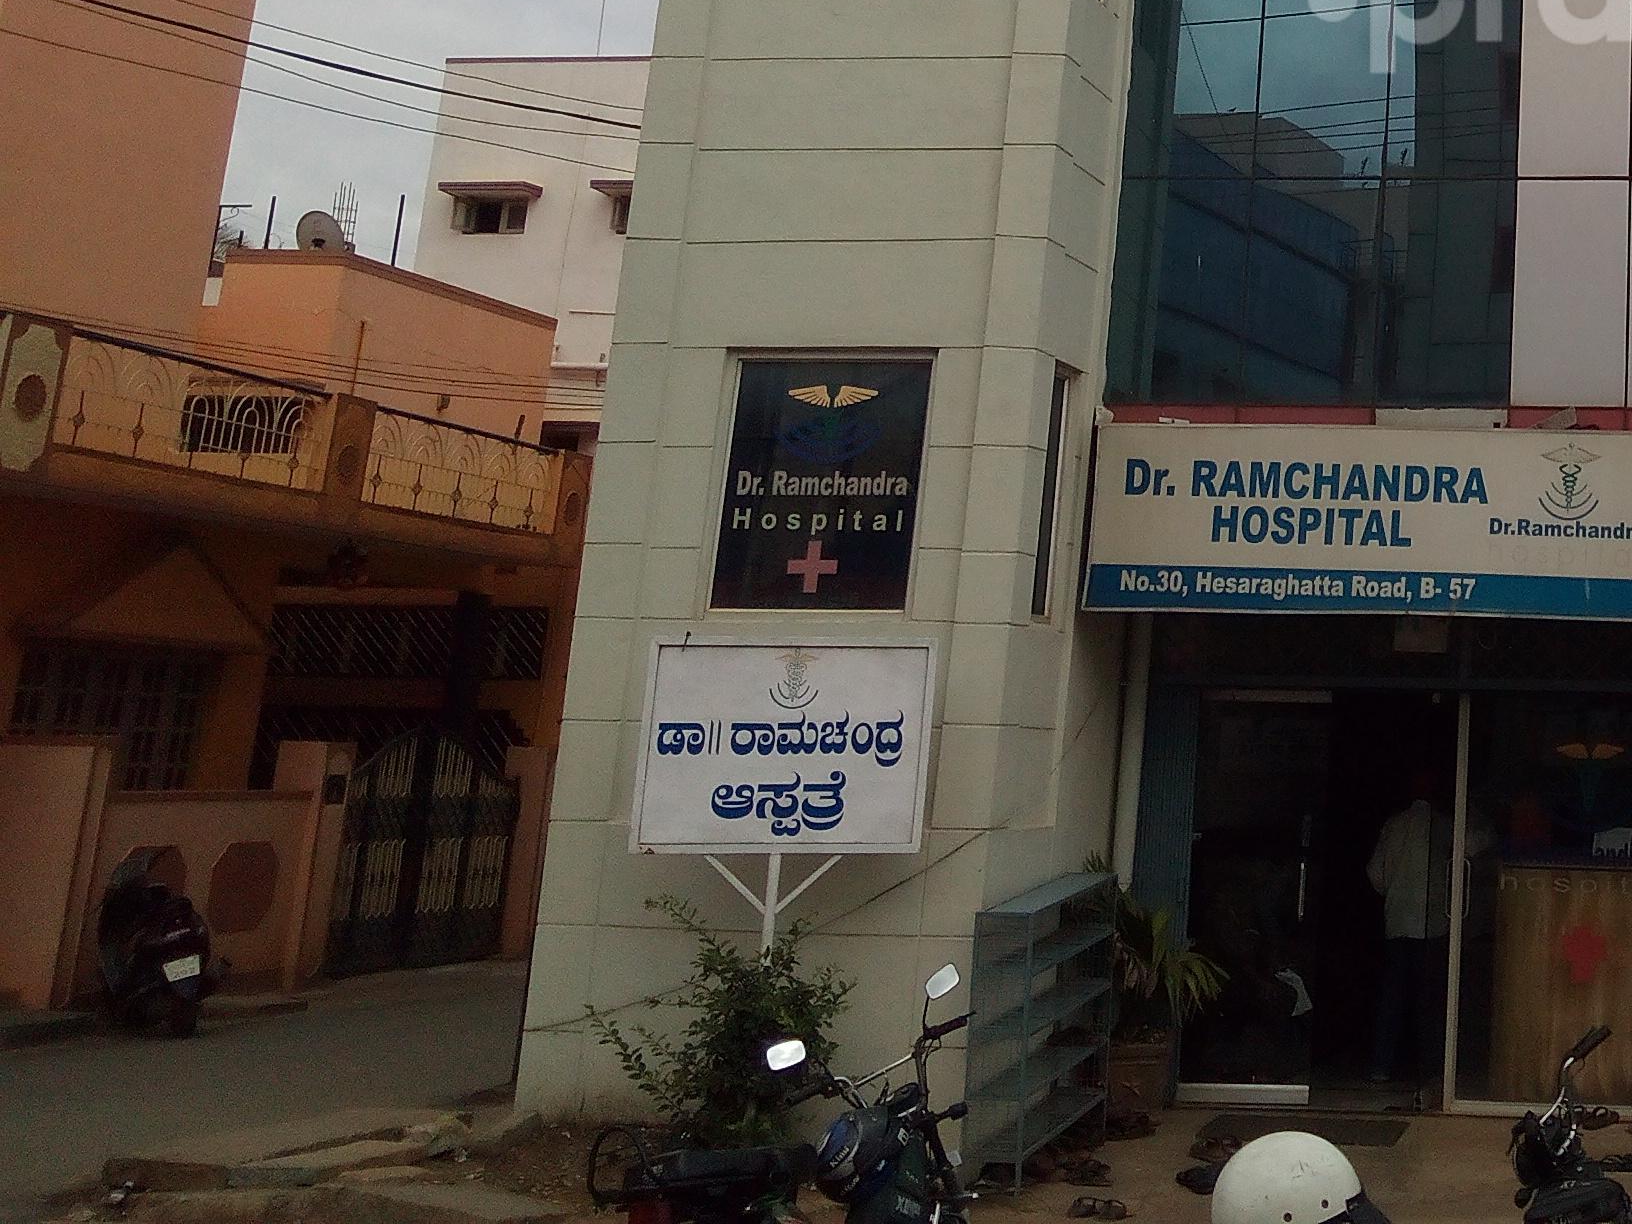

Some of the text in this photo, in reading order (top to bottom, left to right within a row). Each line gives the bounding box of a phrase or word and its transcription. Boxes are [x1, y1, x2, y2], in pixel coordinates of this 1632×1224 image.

[735, 470, 908, 498] Dr. Ramchandra
[1124, 458, 1488, 505] Dr. RAMCHANDRA
[732, 507, 903, 536] Hospital
[1210, 506, 1412, 548] HOSPITAL
[1119, 570, 1188, 596] No.30,
[1195, 572, 1344, 602] Hesaraghatta
[1351, 577, 1414, 604] Road,
[729, 709, 905, 768] ರಾಮಚಂದ್ರ
[711, 770, 848, 837] ಆಸ್ಪತ್ರೆ
